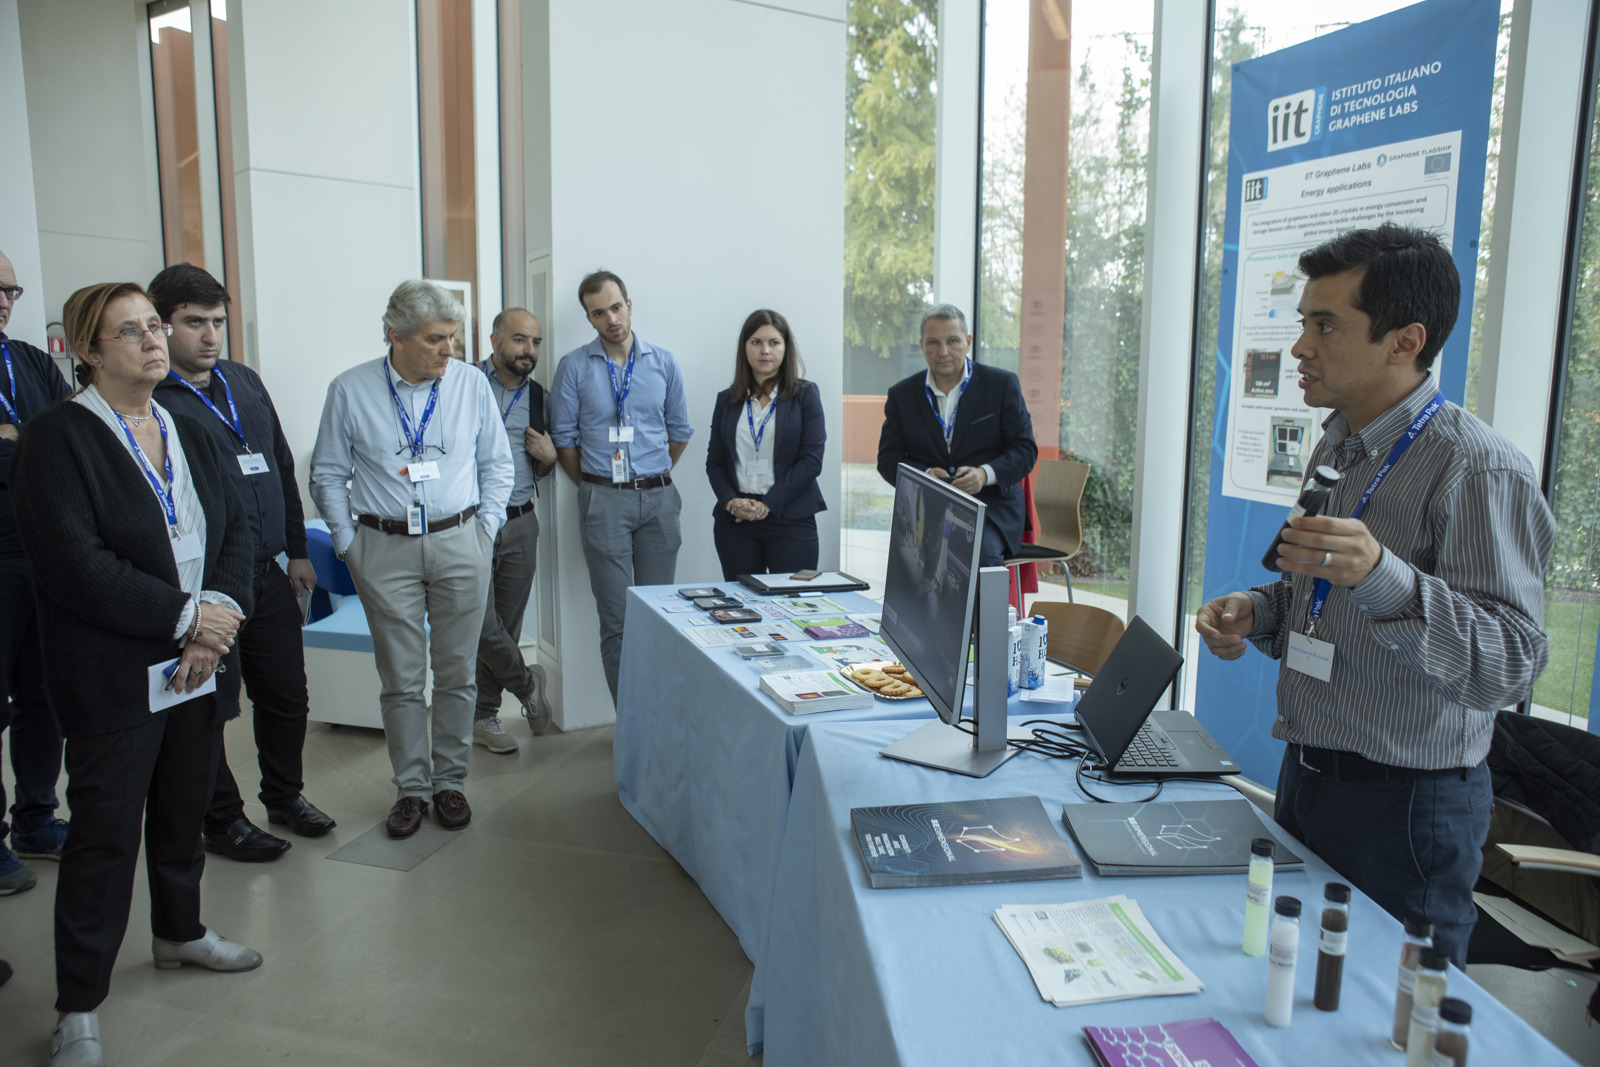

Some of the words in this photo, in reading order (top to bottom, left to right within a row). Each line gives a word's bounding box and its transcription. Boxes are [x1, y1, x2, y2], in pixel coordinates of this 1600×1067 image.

[1332, 78, 1381, 102] ISTITUTO
[1384, 61, 1442, 87] ITALIANO
[1330, 104, 1341, 117] DI
[1344, 84, 1417, 113] TECNOLOGIA
[1272, 100, 1309, 144] iit
[1314, 93, 1324, 136] GRAPHENE
[1328, 110, 1386, 132] GRAPHENE
[1389, 100, 1419, 118] LABS
[1388, 151, 1420, 162] GRAPHENE
[1421, 145, 1452, 155] FLAGSHIP
[1315, 166, 1350, 179] Graphene
[1352, 161, 1371, 172] Labs
[1246, 180, 1263, 201] iit
[1301, 187, 1325, 198] Energy
[1327, 180, 1372, 194] applications
[1350, 213, 1376, 222] challenges
[1395, 206, 1424, 215] increasing
[1365, 203, 1383, 211] energy
[1384, 199, 1414, 208] conversion
[1412, 414, 1430, 431] Tetra
[1425, 401, 1440, 416] Pak
[1366, 476, 1380, 495] Tetra
[1378, 462, 1391, 477] Pak
[1313, 598, 1324, 614] Pak
